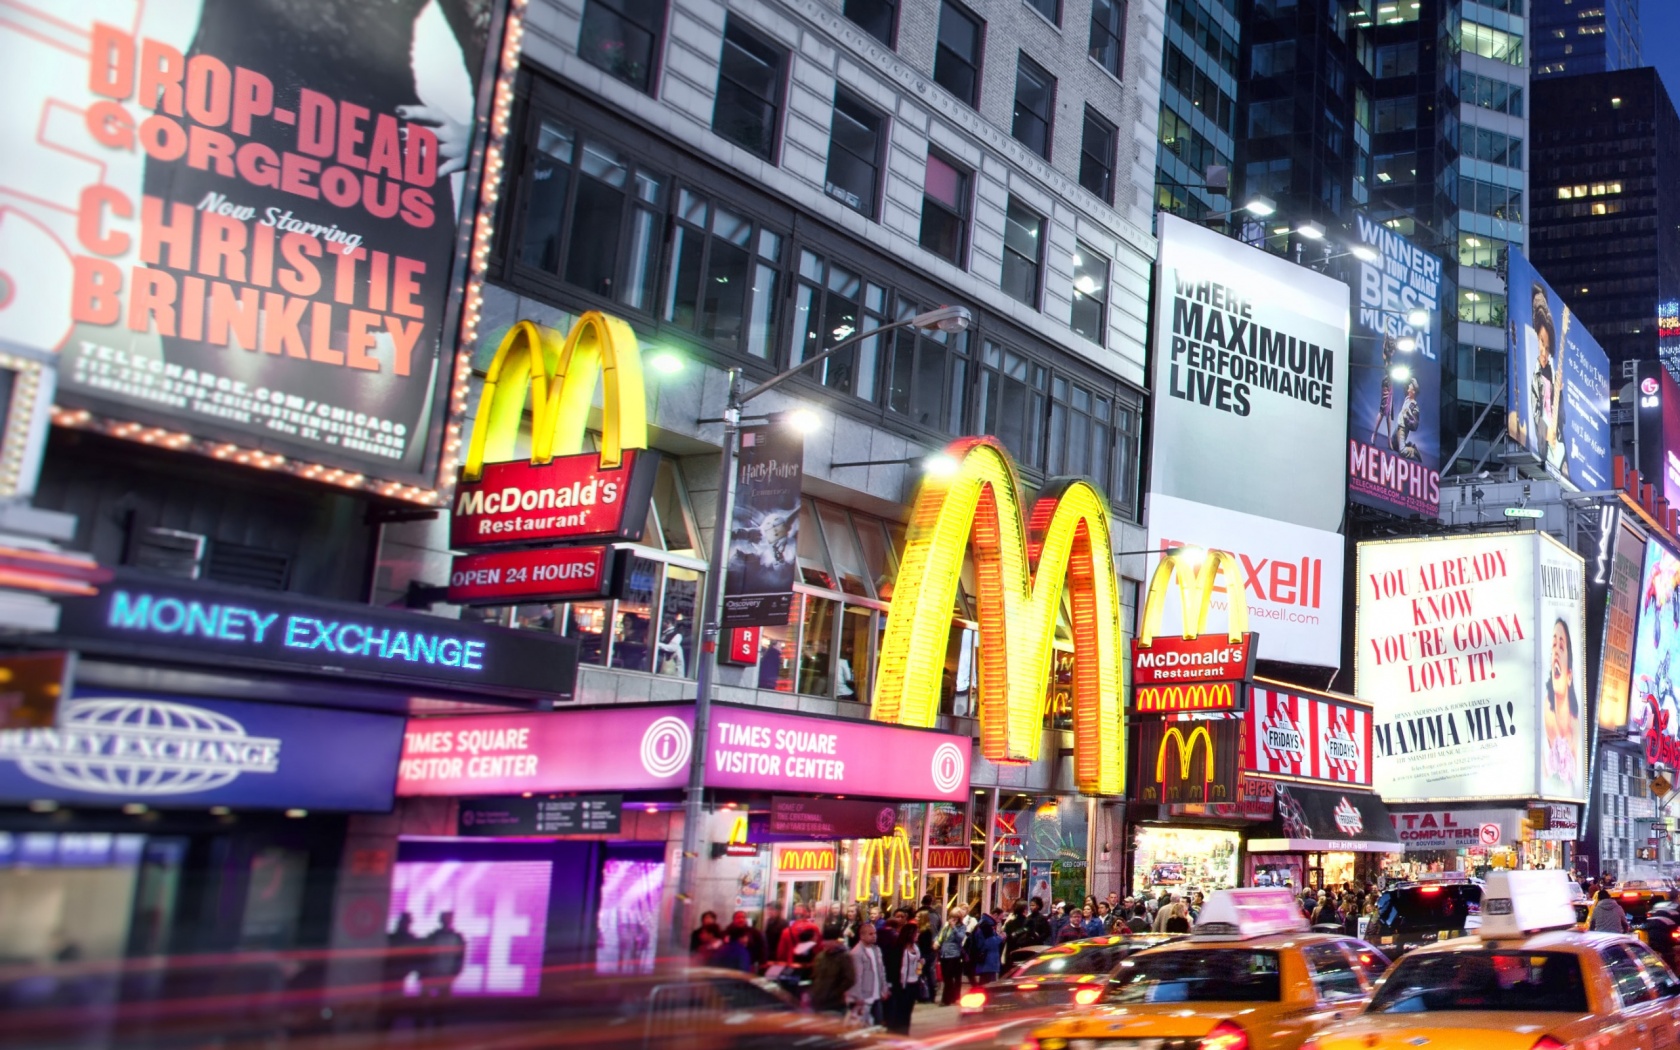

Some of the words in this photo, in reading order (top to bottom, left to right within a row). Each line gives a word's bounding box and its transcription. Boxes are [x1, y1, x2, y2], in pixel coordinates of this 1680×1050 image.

[89, 21, 438, 188] DROP-DEAD
[84, 100, 436, 229] GORGEOUS
[197, 191, 256, 222] Now
[263, 205, 363, 255] Starring
[77, 184, 427, 319] CHRISTIE
[1358, 215, 1440, 284] WINNER!
[71, 254, 424, 376] BRINKLEY
[1174, 268, 1252, 320] WHERE
[1361, 262, 1437, 335] BEST
[1173, 296, 1334, 384] MAXIMUM
[1360, 302, 1436, 360] MUSICAL
[1170, 363, 1251, 417] LIVES
[1171, 335, 1333, 410] PERFORMANCE
[456, 479, 618, 517] McDonald's
[1350, 440, 1440, 504] MEMPHIS
[479, 512, 586, 535] Restaurant
[452, 567, 500, 588] OPEN
[506, 567, 528, 584] 24
[532, 562, 596, 582] HOURS
[1369, 567, 1411, 601] YOU
[1417, 549, 1508, 594] ALREADY
[109, 592, 278, 643] MONEY
[284, 616, 486, 670] EXCHANGE
[1411, 588, 1475, 627] KNOW
[1136, 648, 1242, 667] McDonald's
[1370, 627, 1447, 666] YOU'RE
[1453, 613, 1526, 652] GONNA
[1154, 667, 1225, 679] Restaurant
[1407, 657, 1462, 693] LOVE
[1467, 649, 1496, 683] IT!
[112, 735, 280, 765] EXCHANGE
[457, 728, 530, 754] SQUARE
[717, 722, 772, 749] TIMES
[775, 728, 837, 755] SQUARE
[1375, 712, 1462, 758] MAMMA
[1465, 701, 1517, 744] MIA!
[467, 755, 539, 778] CENTER
[715, 750, 780, 776] VISITOR
[785, 756, 844, 781] CENTER
[1400, 828, 1480, 840] COMPUTERS
